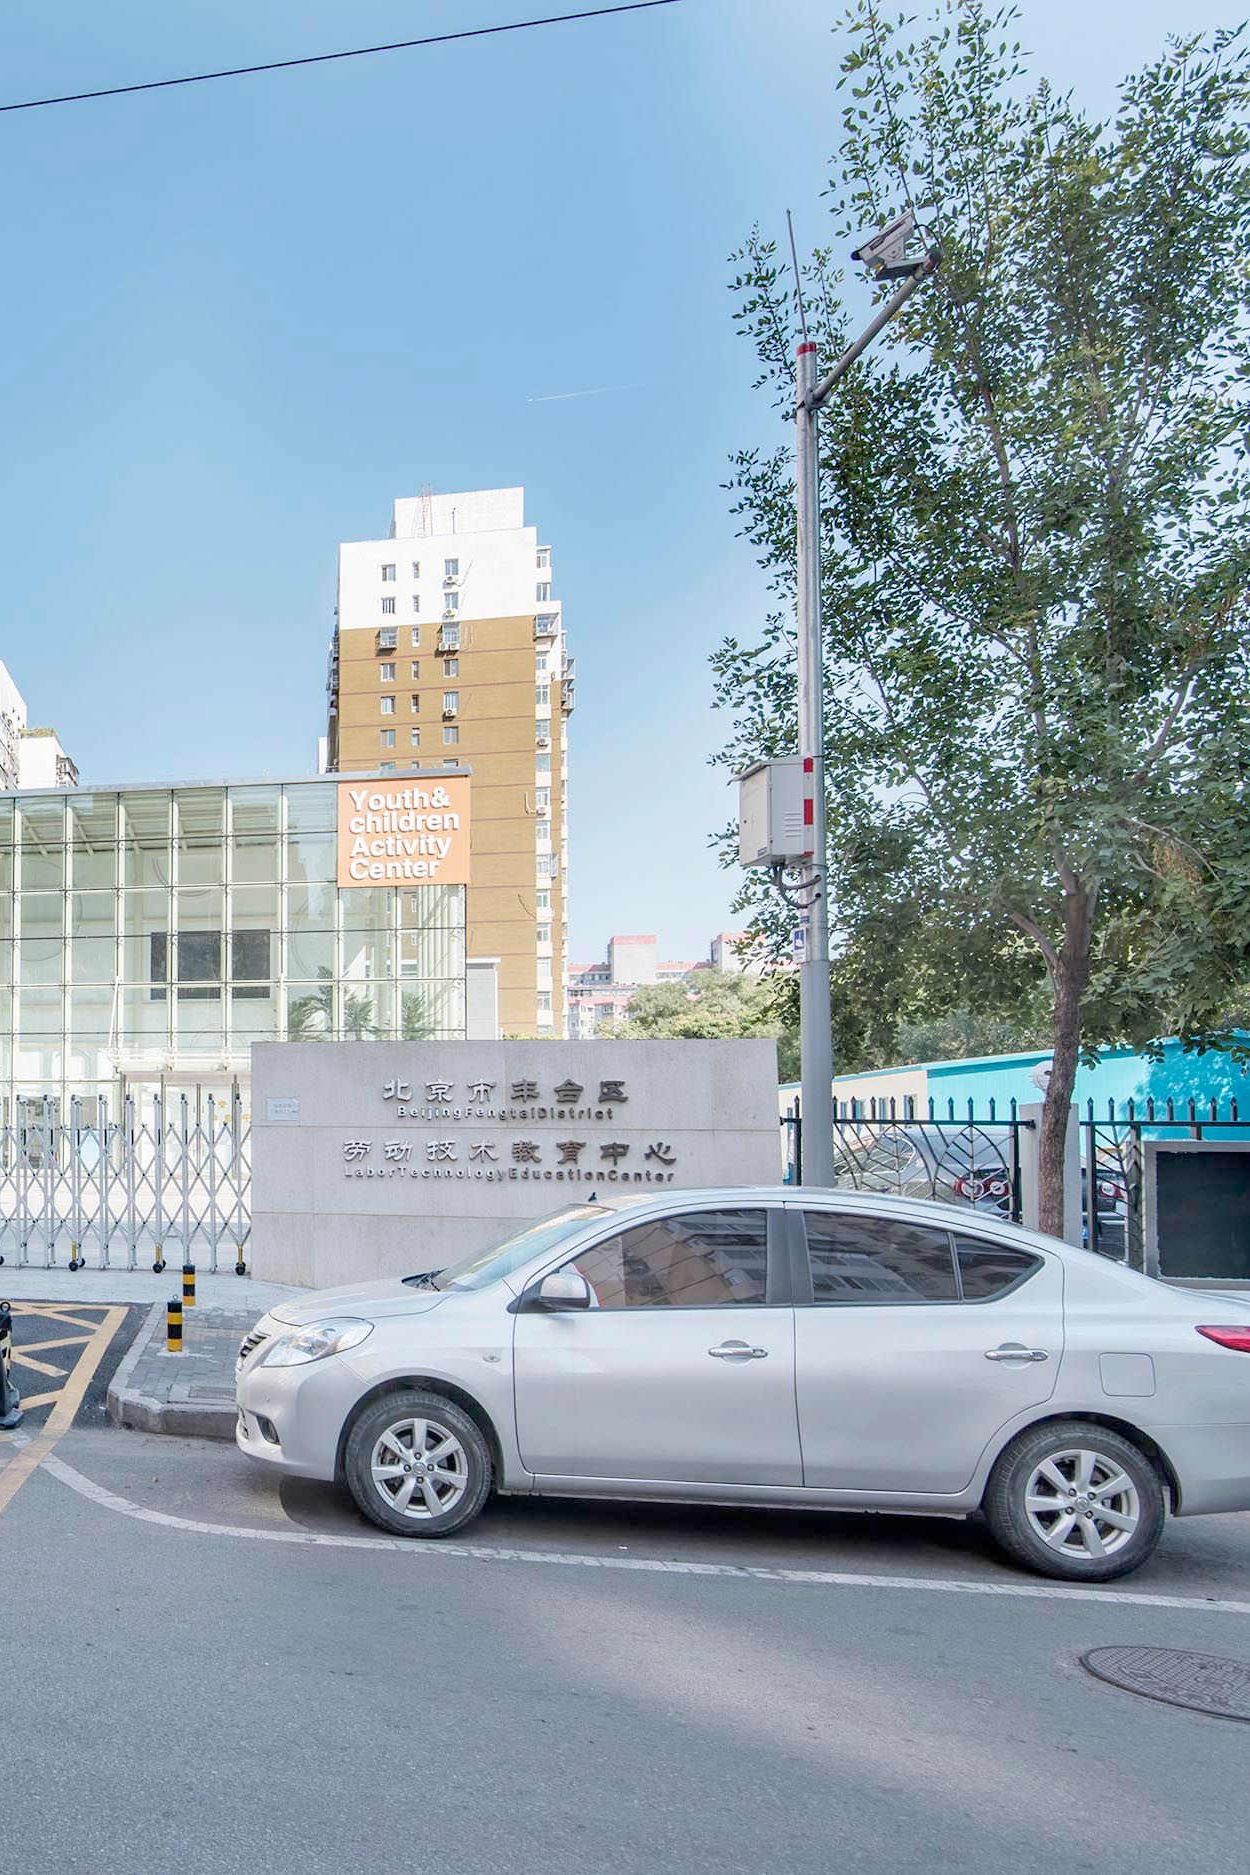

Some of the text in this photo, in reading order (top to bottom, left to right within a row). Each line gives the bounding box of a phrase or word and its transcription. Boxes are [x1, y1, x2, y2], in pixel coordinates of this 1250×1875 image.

[349, 786, 451, 812] Youth&
[349, 811, 460, 834] children
[349, 834, 453, 860] Activity
[349, 857, 442, 880] Center
[382, 1078, 629, 1103] 北京市丰台区
[343, 1139, 678, 1166] 劳动技术教育中心
[343, 1166, 675, 1183] LaborTechnologyEducationCenter
